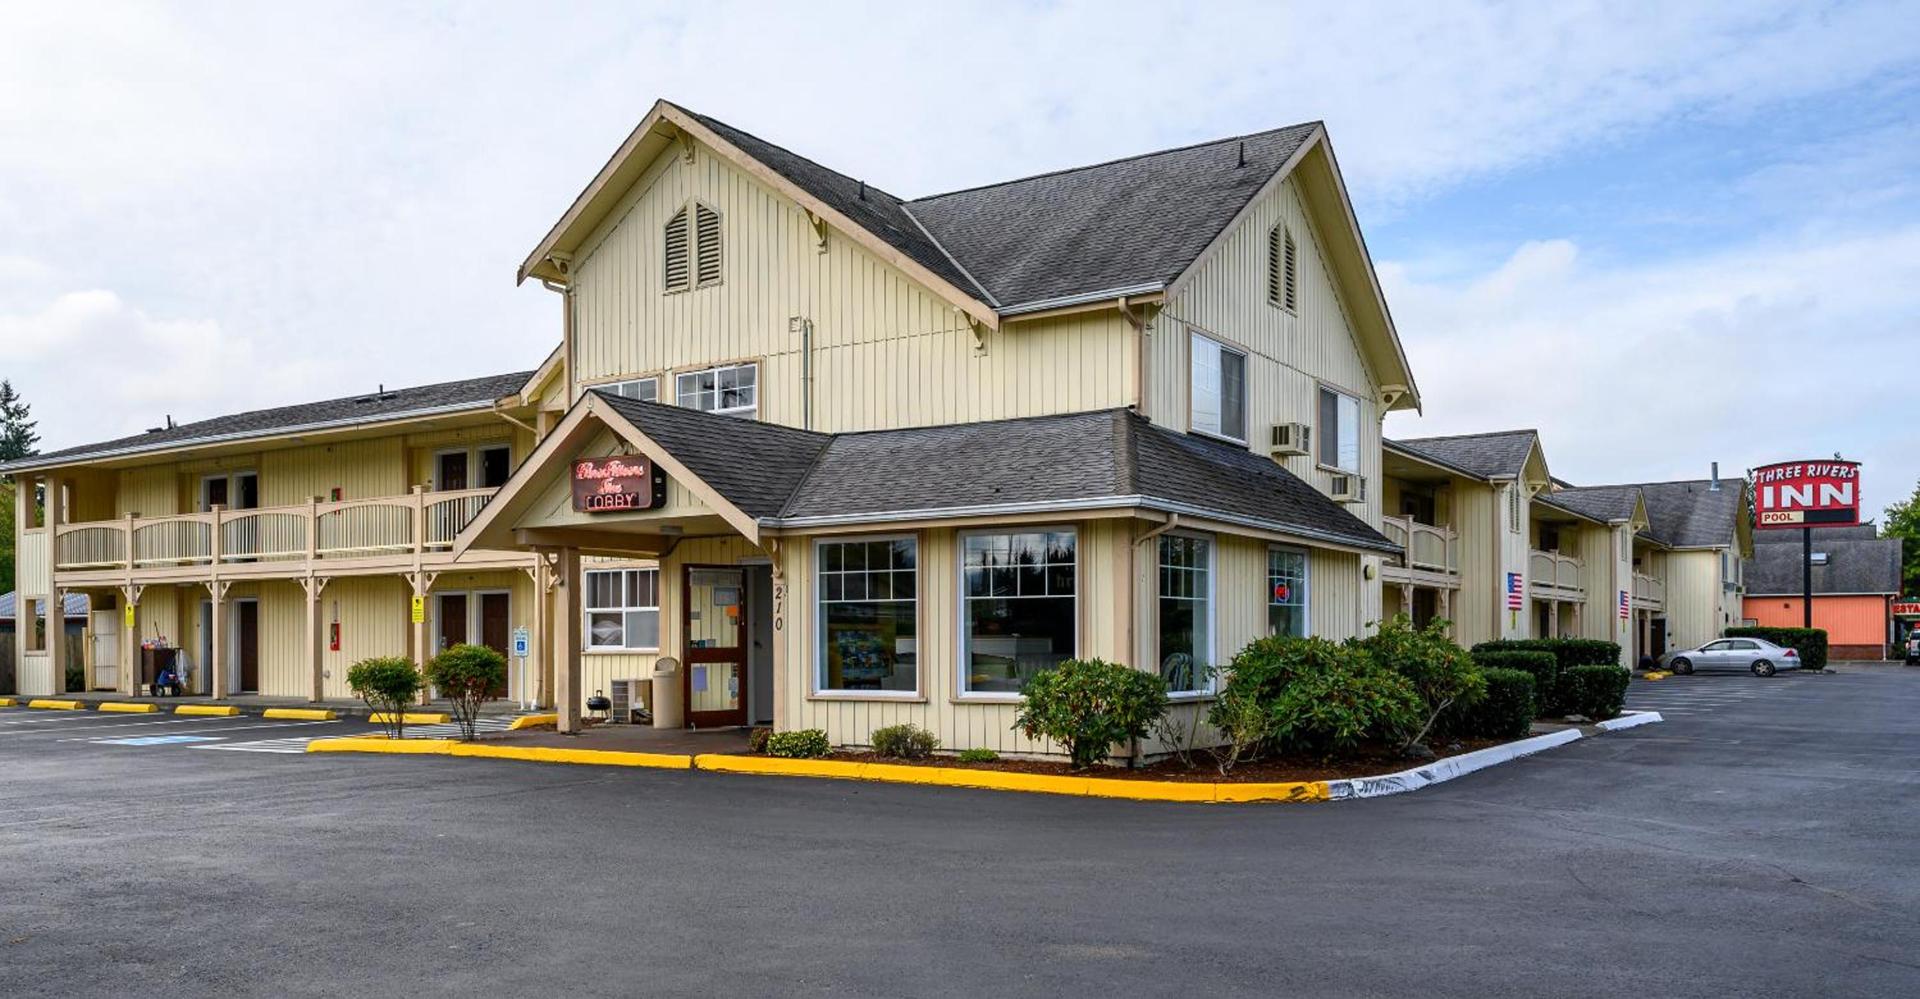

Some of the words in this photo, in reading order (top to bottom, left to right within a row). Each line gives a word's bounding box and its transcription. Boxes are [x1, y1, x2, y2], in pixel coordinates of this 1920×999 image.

[1759, 465, 1802, 483] THREE
[1807, 464, 1857, 478] RIVERS
[586, 494, 635, 510] LOBBY
[1763, 482, 1853, 508] INN
[1764, 513, 1793, 522] POOL
